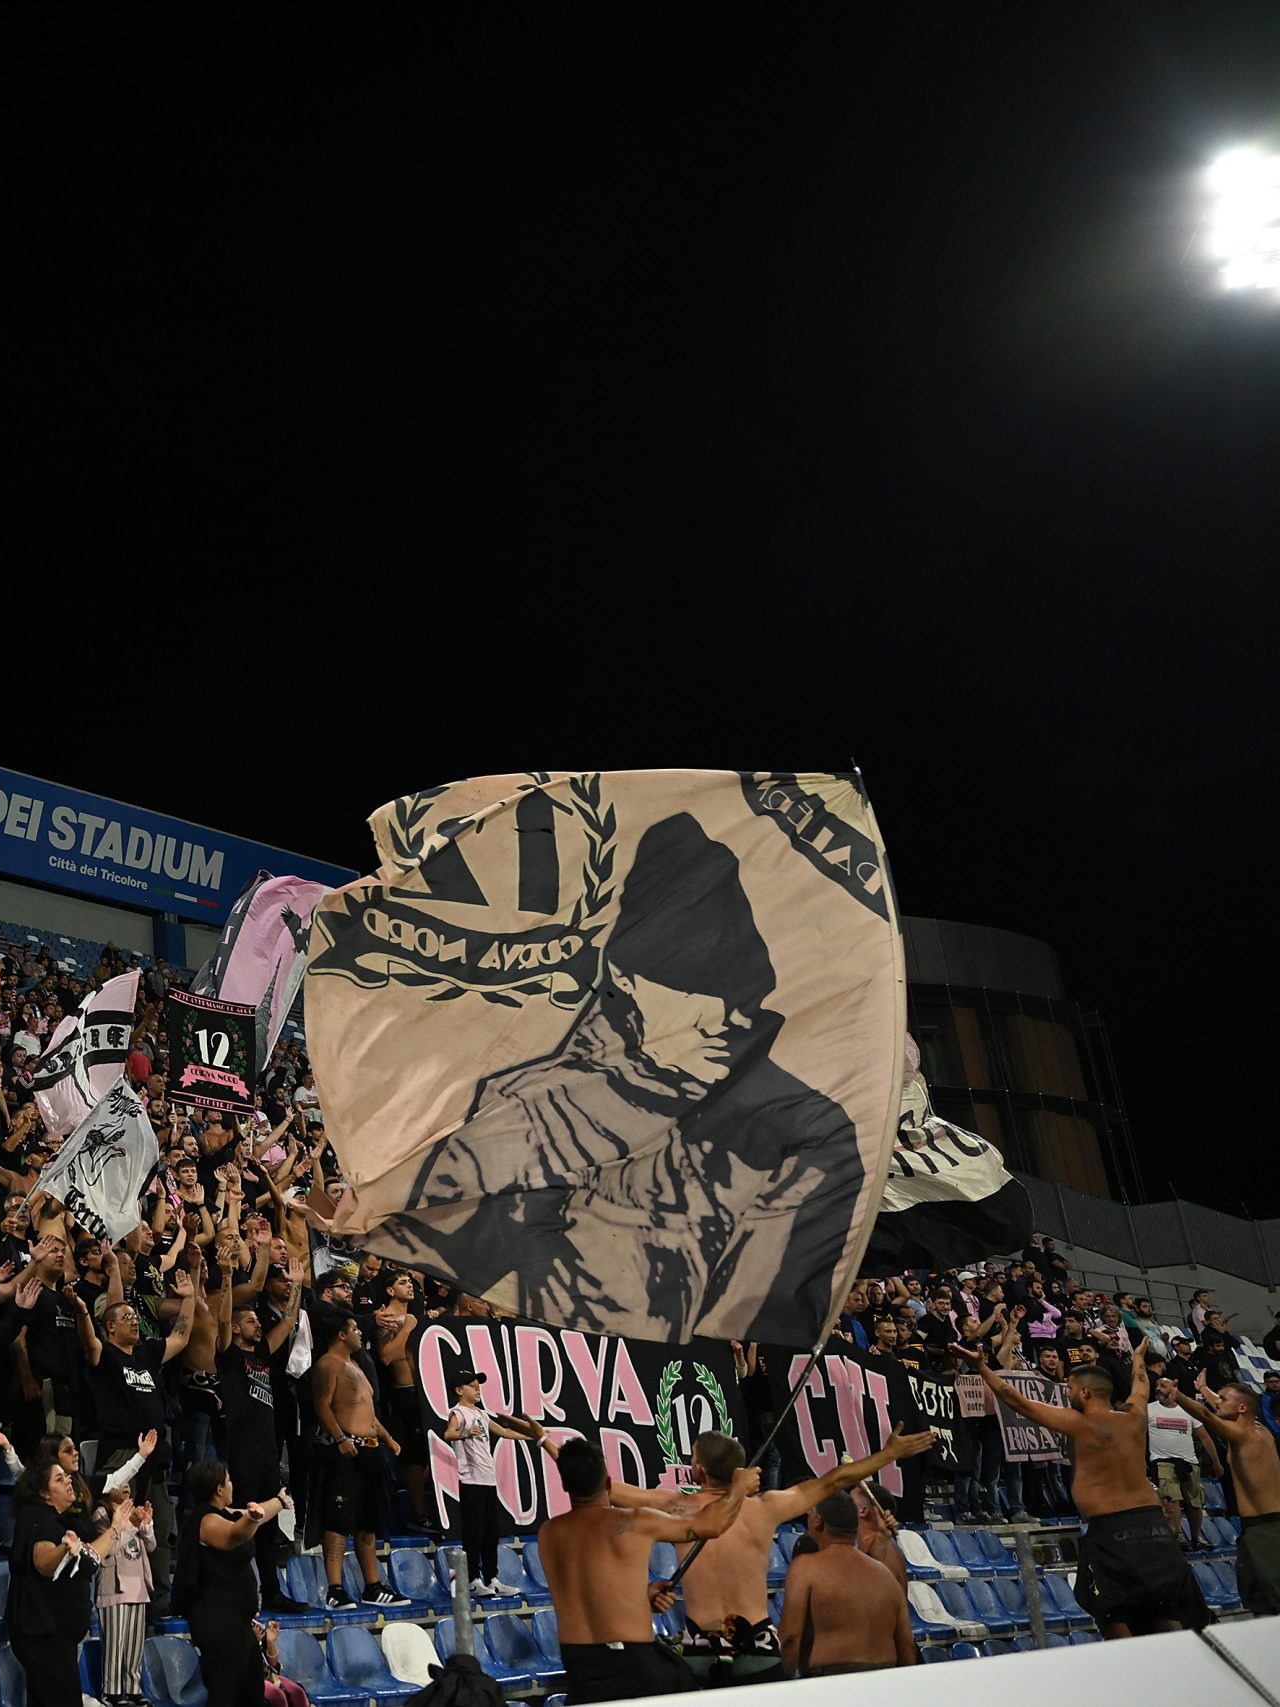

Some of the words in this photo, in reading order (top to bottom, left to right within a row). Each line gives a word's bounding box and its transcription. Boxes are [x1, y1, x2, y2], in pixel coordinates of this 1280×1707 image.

[48, 806, 225, 890] STADIUM
[48, 856, 77, 872] Città
[79, 864, 98, 878] del
[100, 867, 148, 890] Tricolore
[194, 1028, 230, 1069] 12
[190, 1068, 215, 1080] CURVA
[217, 1074, 239, 1085] NORD
[419, 1324, 655, 1426] CURVA
